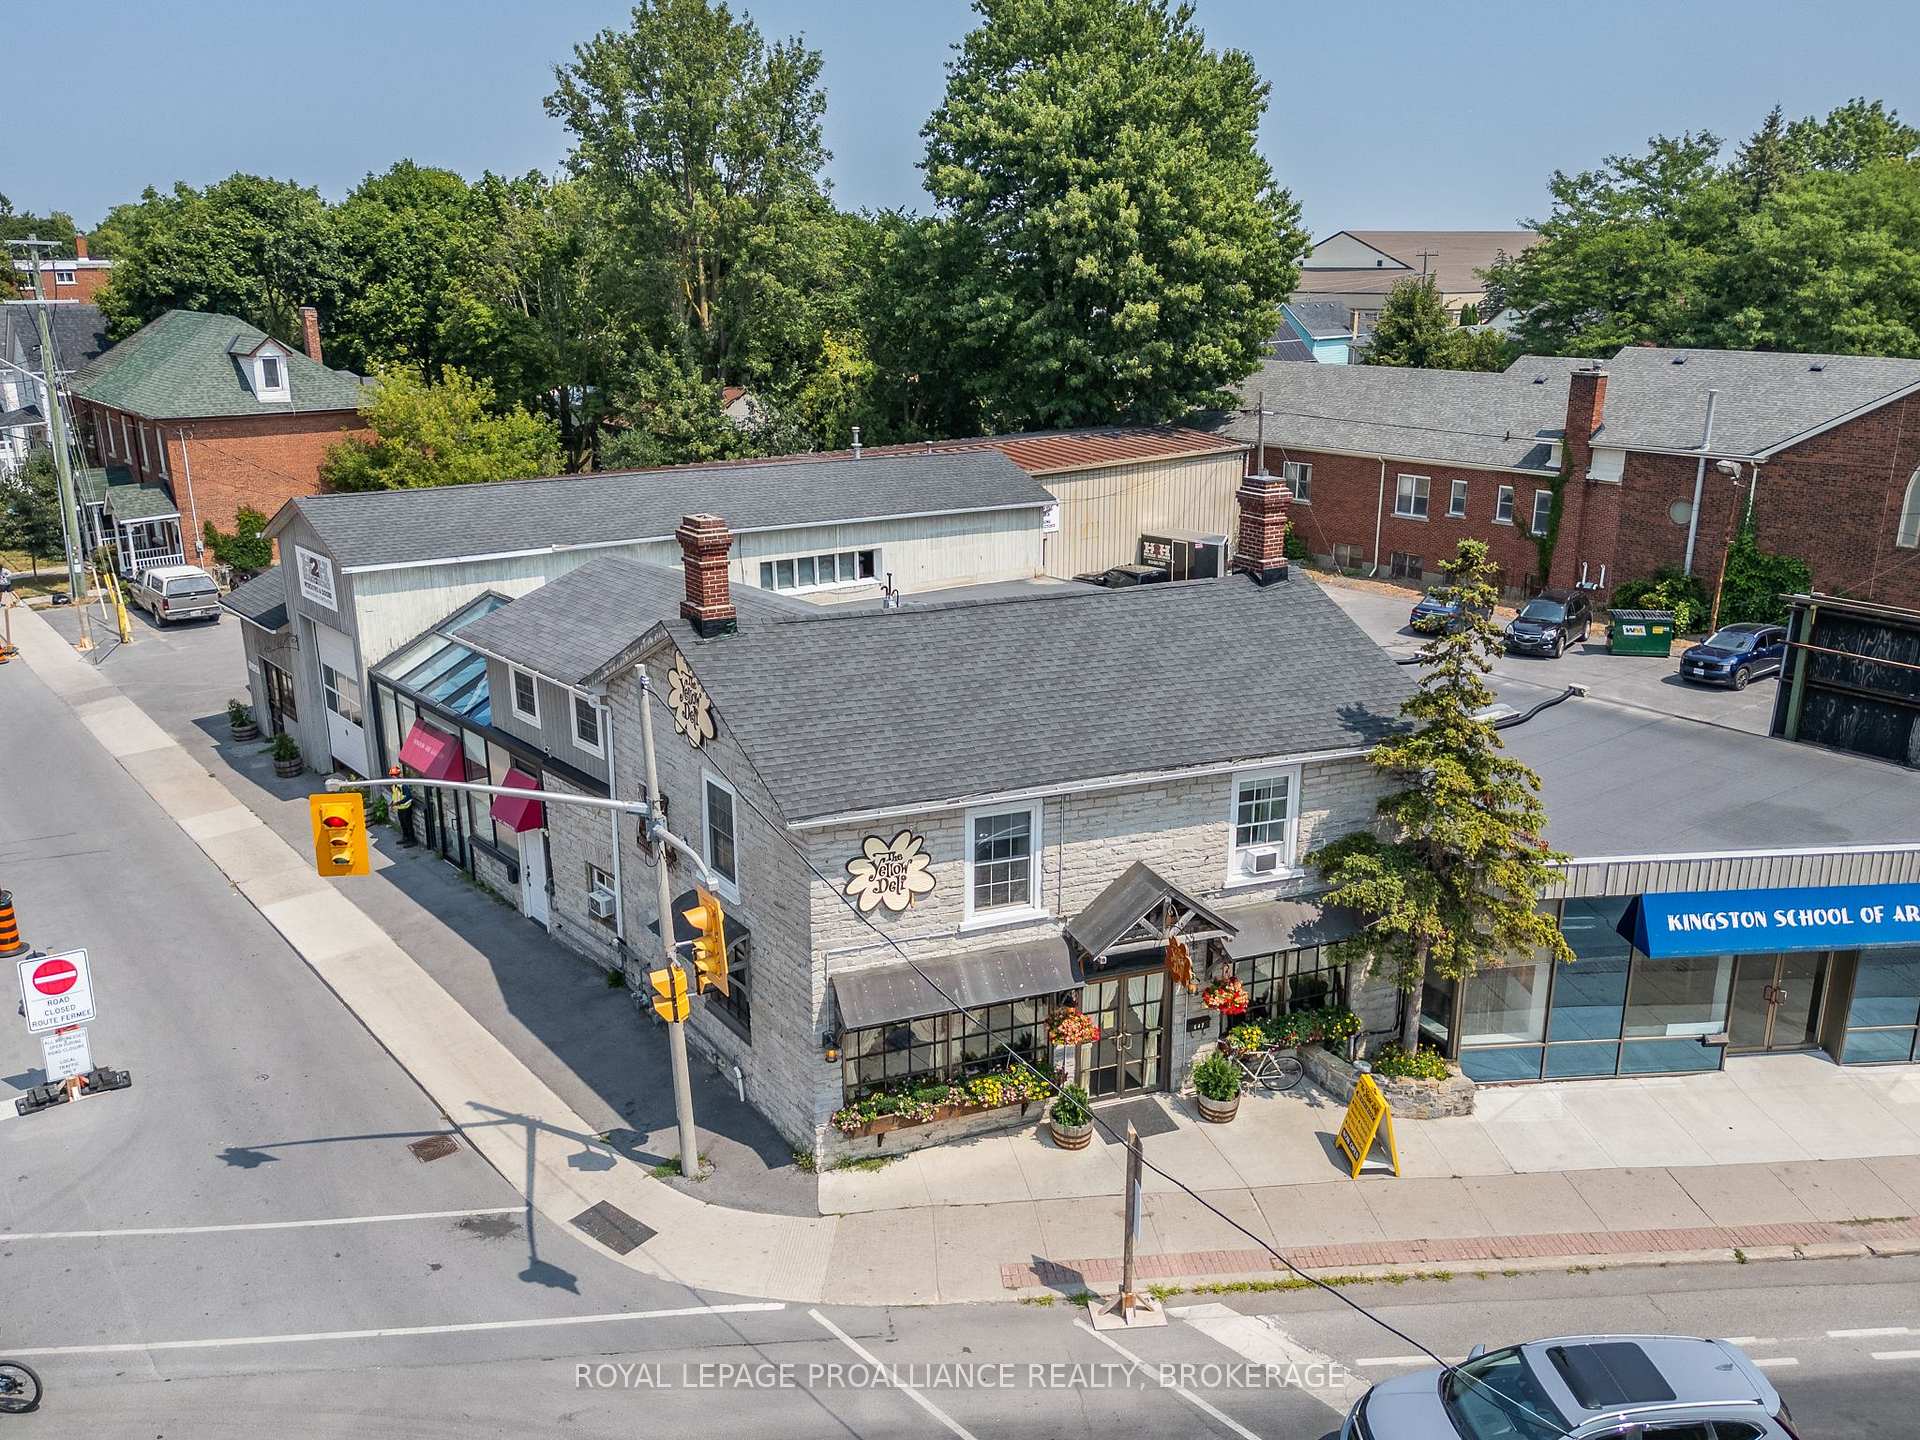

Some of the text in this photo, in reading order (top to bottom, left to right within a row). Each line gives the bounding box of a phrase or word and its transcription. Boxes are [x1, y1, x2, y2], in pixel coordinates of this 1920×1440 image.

[309, 557, 320, 577] 2
[872, 851, 903, 861] The
[867, 858, 912, 882] Yellow
[872, 876, 907, 895] Deli
[1667, 910, 1767, 932] KINGSTON
[1773, 906, 1854, 928] SCHOOL
[1860, 905, 1884, 924] OF
[47, 996, 70, 1006] ROAD
[44, 1004, 76, 1016] CLOSED
[32, 1017, 58, 1027] ROUTE
